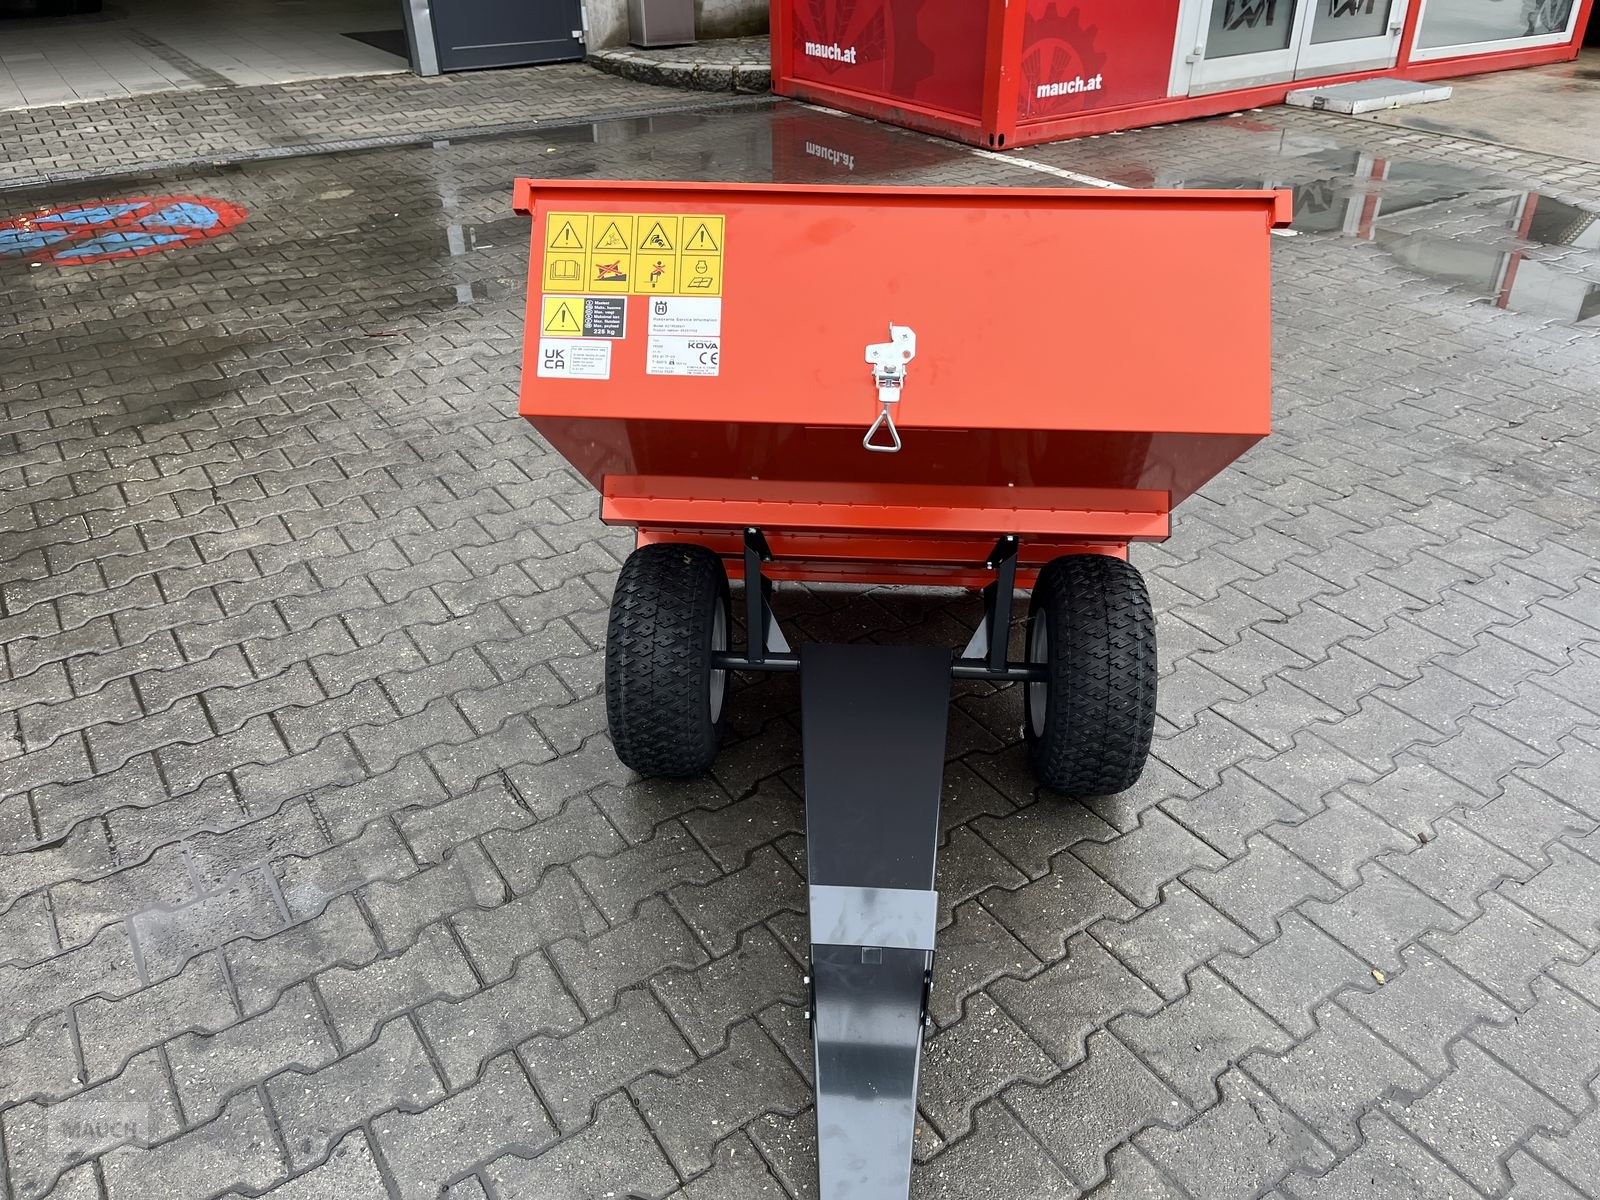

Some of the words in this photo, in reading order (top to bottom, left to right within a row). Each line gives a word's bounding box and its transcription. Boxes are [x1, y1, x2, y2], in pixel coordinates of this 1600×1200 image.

[805, 41, 856, 64] mauch.at
[1036, 73, 1103, 98] mauch.at
[545, 348, 565, 359] UK
[699, 352, 718, 365] CE
[544, 359, 565, 370] CA
